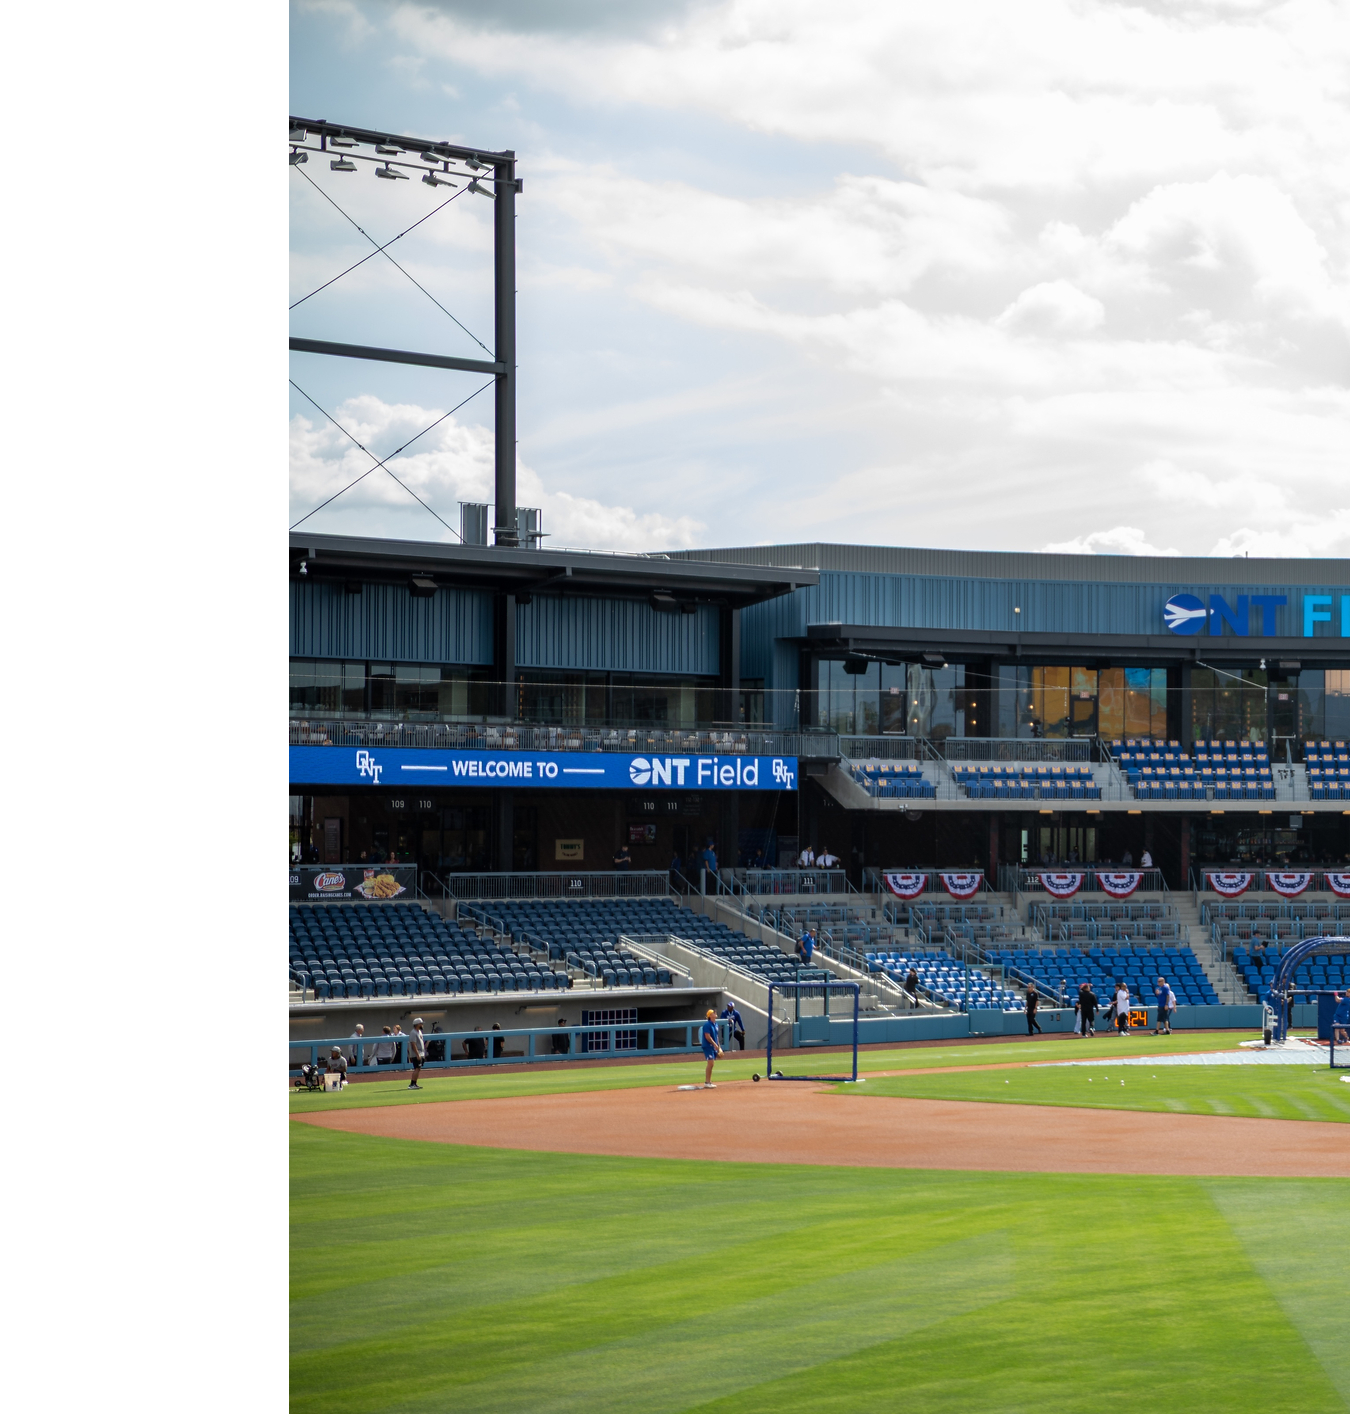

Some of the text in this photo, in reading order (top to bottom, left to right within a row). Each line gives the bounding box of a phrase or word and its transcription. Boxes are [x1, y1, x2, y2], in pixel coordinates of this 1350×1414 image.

[1164, 593, 1287, 636] ONT
[452, 760, 558, 778] WELCOME TO
[629, 757, 758, 786] ONT Field
[391, 800, 432, 809] 109 110
[643, 802, 678, 810] 110 111
[289, 875, 299, 883] 09
[570, 879, 582, 887] 110
[803, 877, 814, 885] 111
